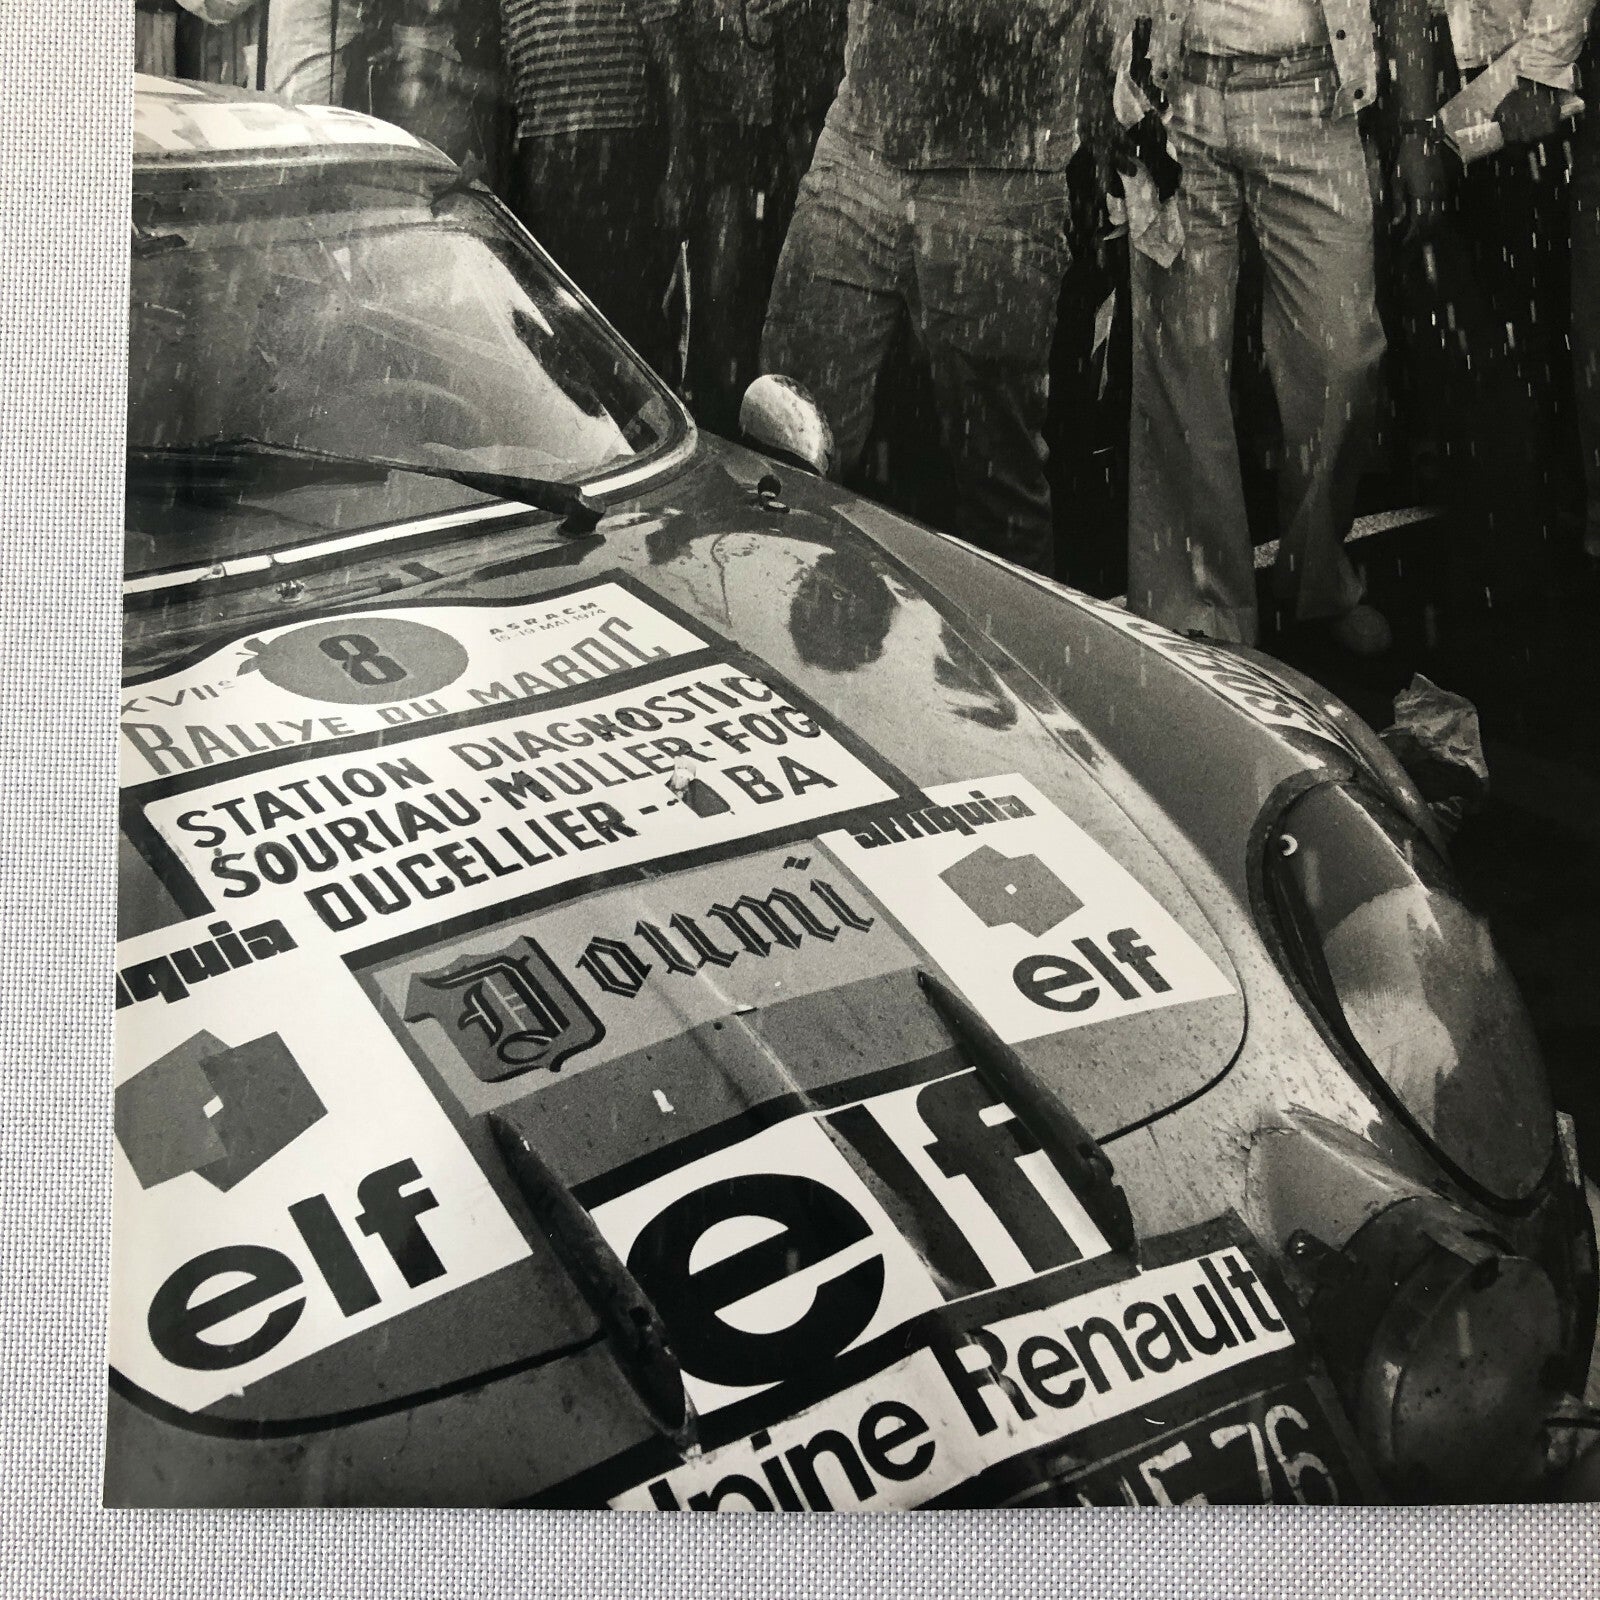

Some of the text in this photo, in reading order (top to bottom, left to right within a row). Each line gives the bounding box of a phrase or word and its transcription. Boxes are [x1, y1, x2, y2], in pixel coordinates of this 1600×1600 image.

[120, 616, 672, 776] RALLYE DU MAROC
[318, 634, 407, 685] 8
[176, 676, 774, 848] STATION DIAGNOSTIC
[1012, 927, 1174, 1013] elf
[147, 1157, 448, 1371] elf
[626, 1069, 1085, 1388] elf
[929, 1255, 1286, 1436] Renault
